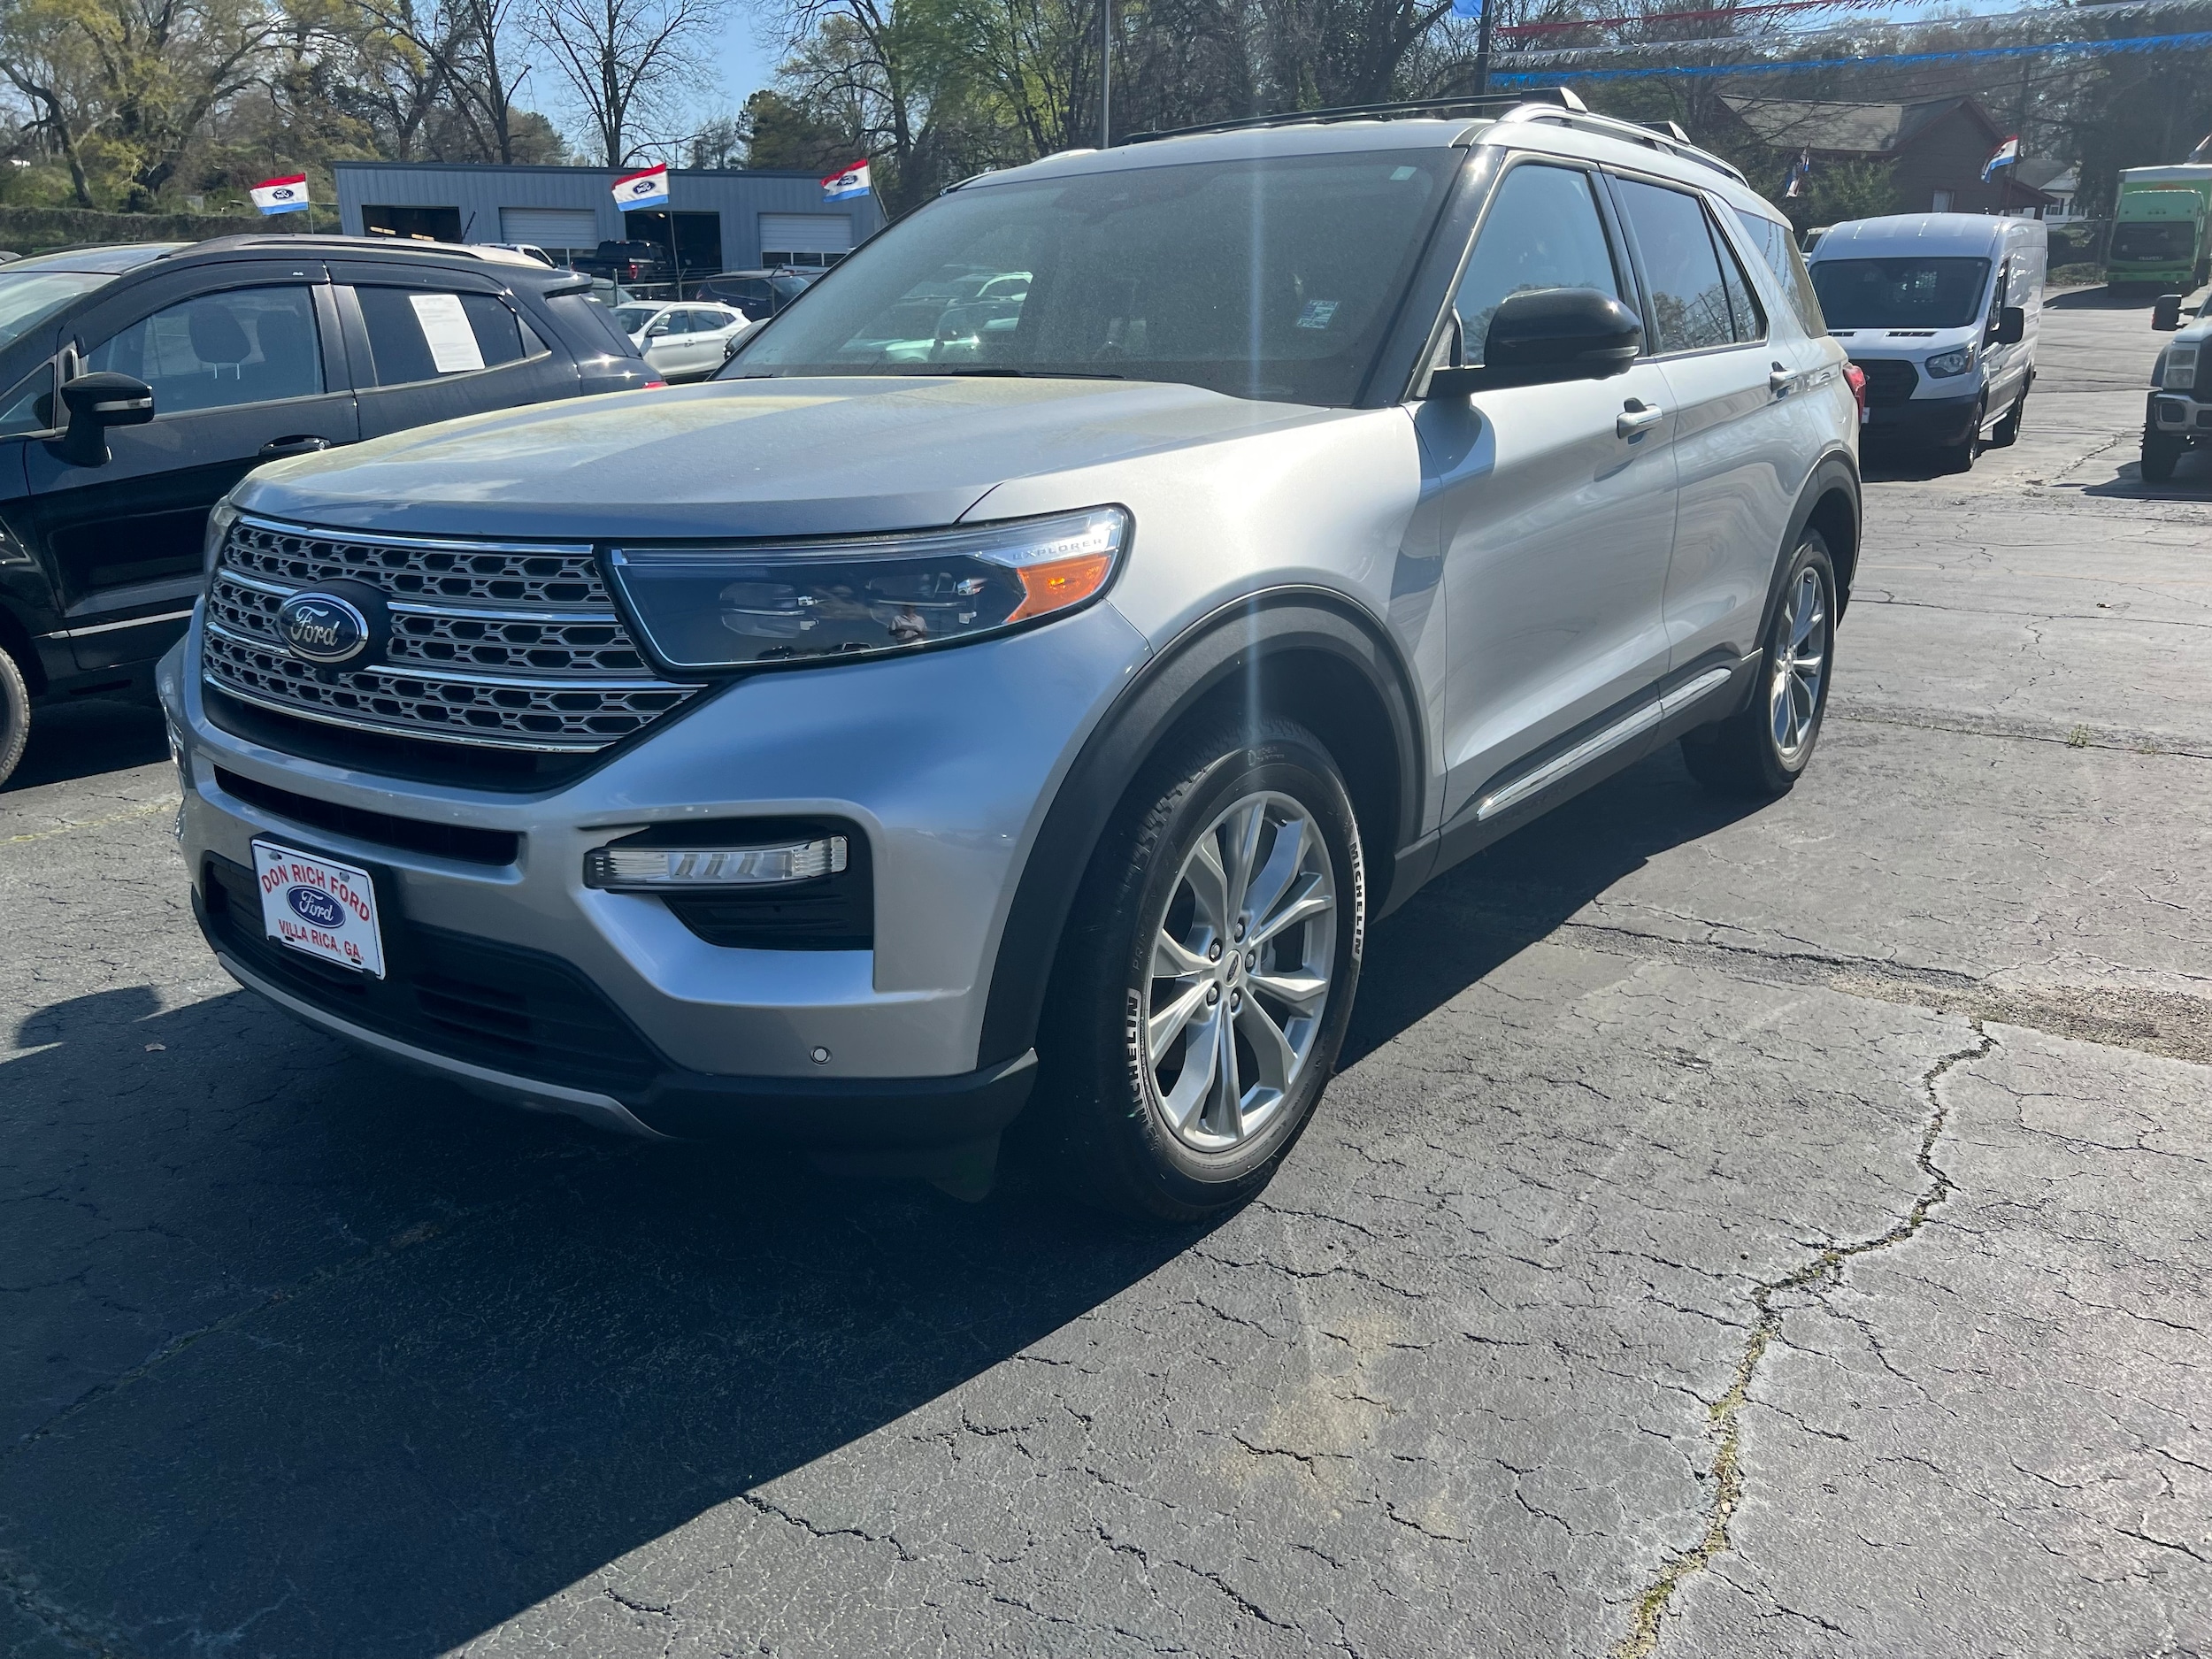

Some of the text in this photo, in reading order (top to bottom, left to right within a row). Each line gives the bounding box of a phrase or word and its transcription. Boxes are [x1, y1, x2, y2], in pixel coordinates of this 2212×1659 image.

[1013, 539, 1102, 560] EXPLORER
[290, 606, 340, 646] Ford
[261, 864, 370, 922] DON RICH FORD
[299, 890, 334, 921] Ford
[1349, 841, 1363, 955] MICHELIN
[278, 918, 309, 942] VILLA
[311, 929, 342, 956] RICA,
